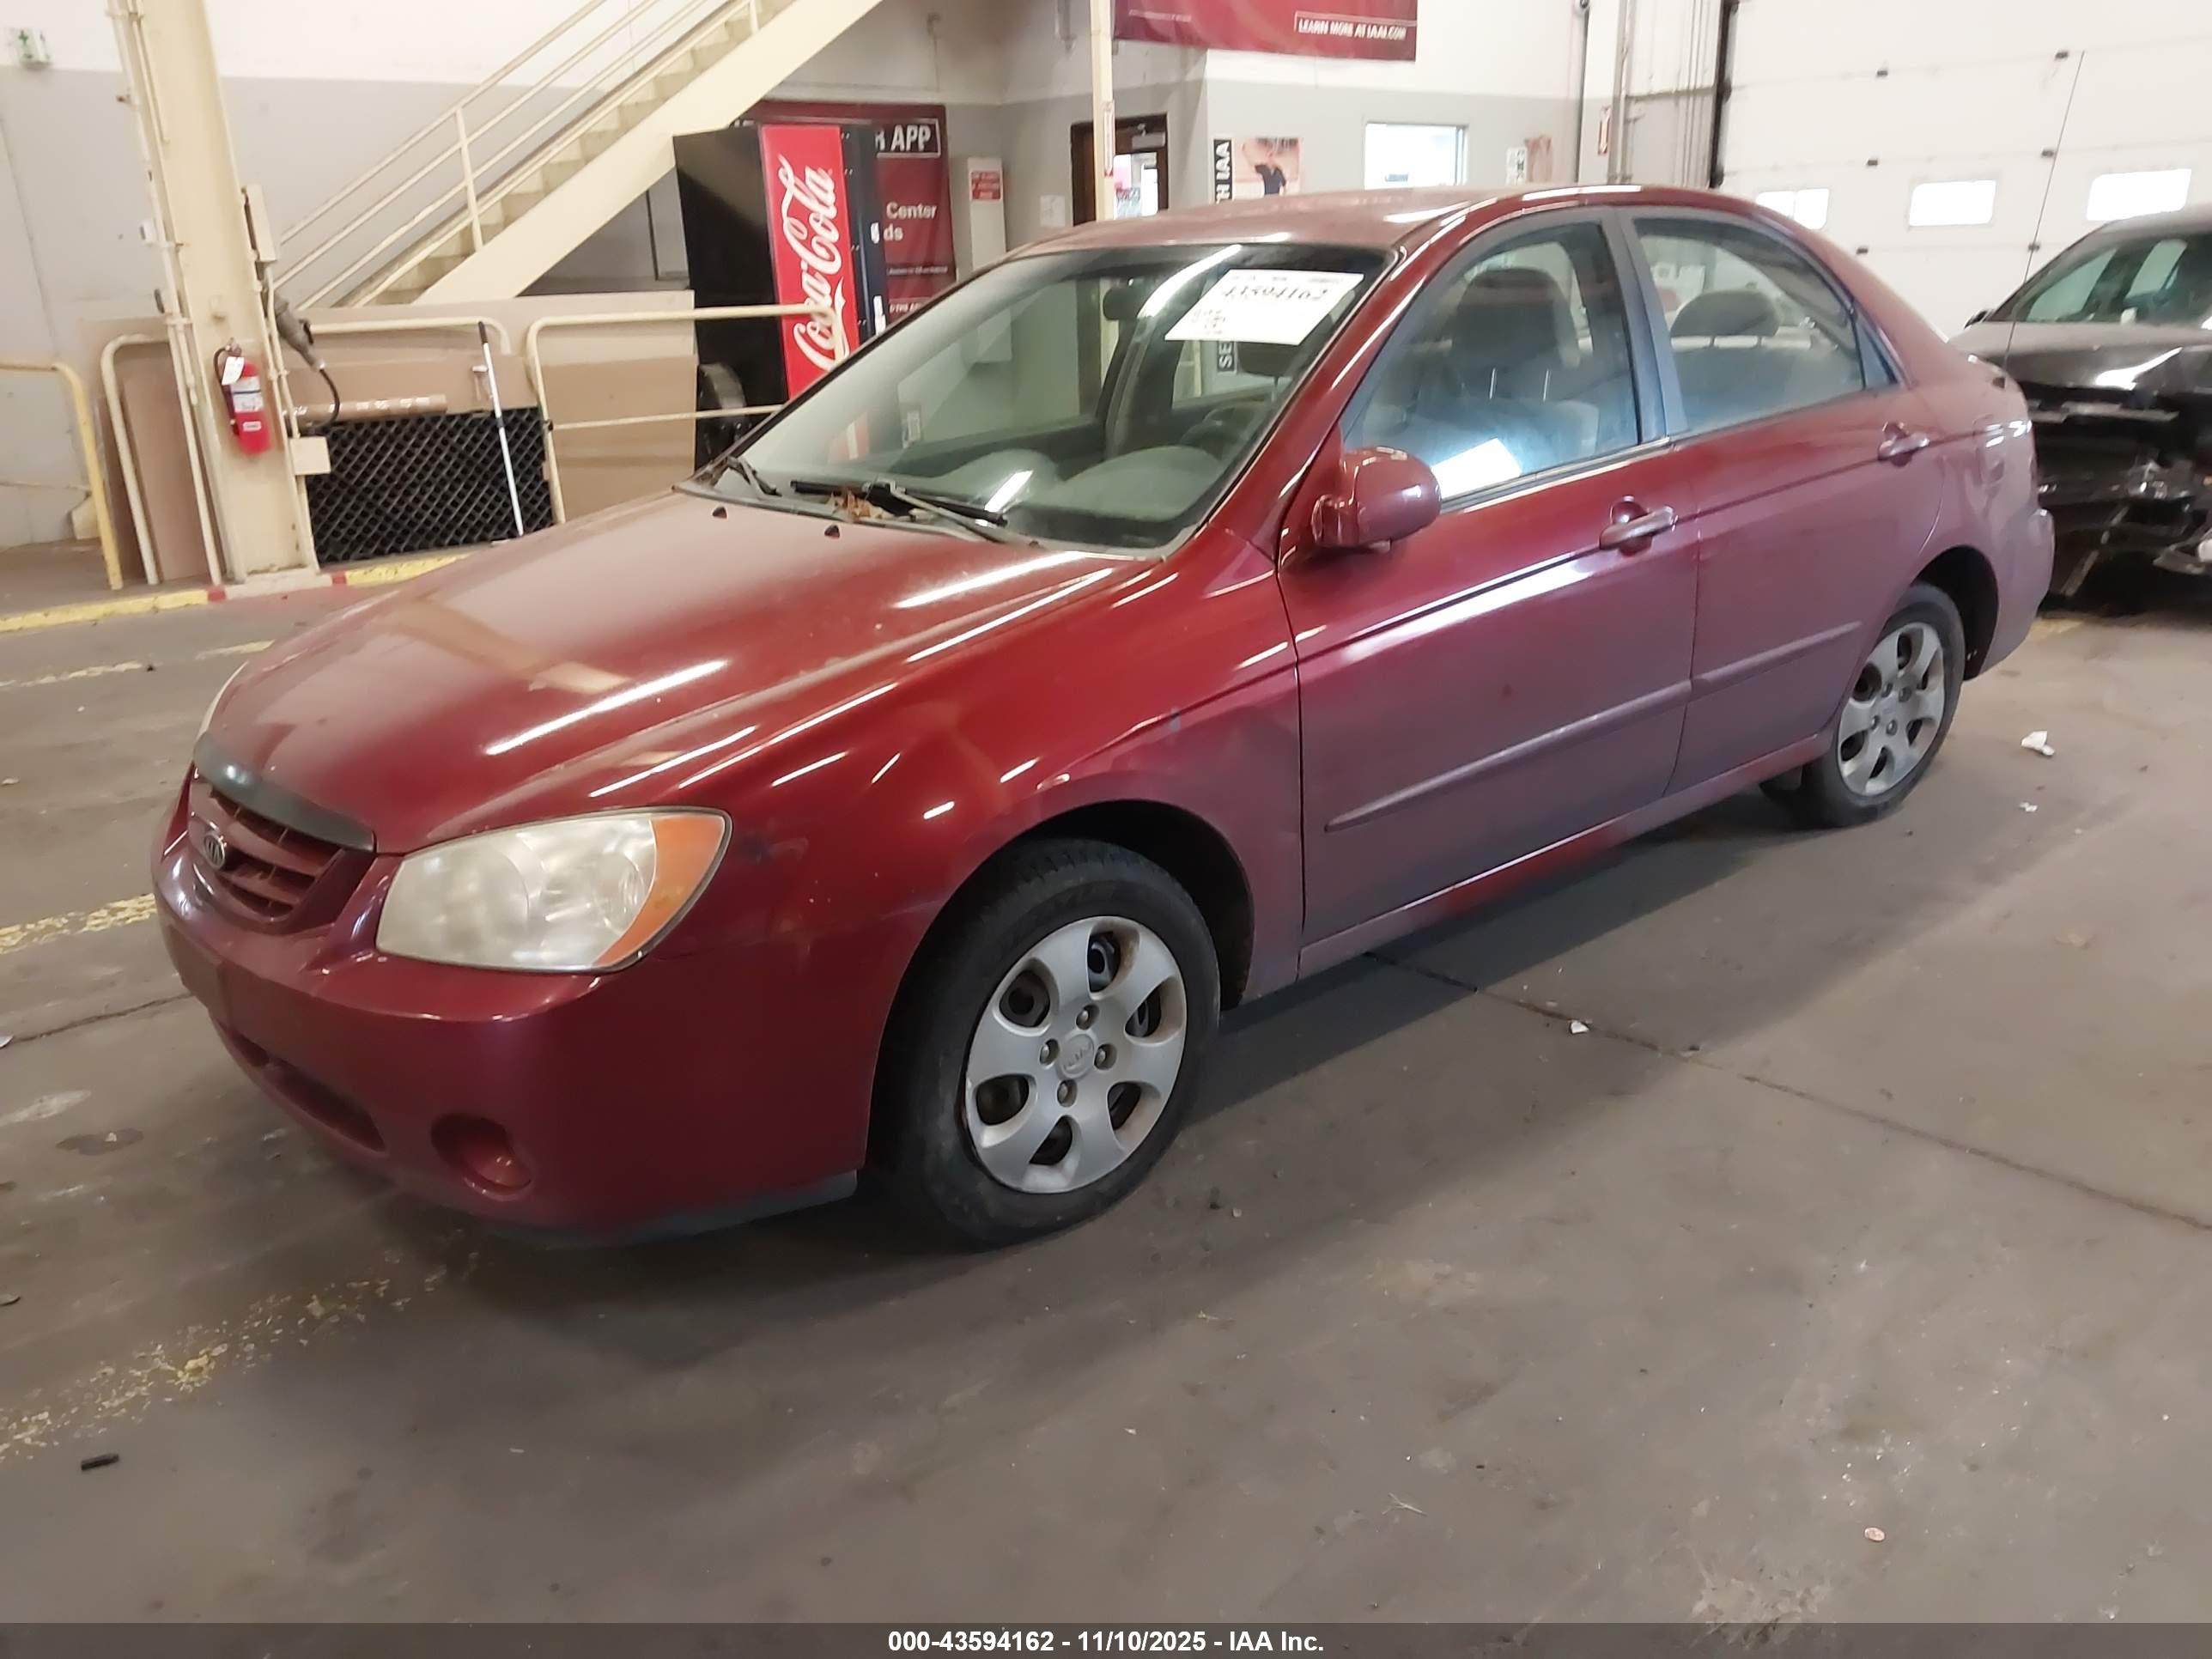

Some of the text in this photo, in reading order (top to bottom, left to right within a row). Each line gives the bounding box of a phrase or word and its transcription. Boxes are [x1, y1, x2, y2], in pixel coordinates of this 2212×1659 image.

[1298, 18, 1329, 35] LEARN
[1330, 21, 1354, 38] MORE
[1354, 23, 1367, 38] AT
[890, 125, 932, 151] APP
[1215, 141, 1231, 180] IAA
[886, 200, 938, 220] Center
